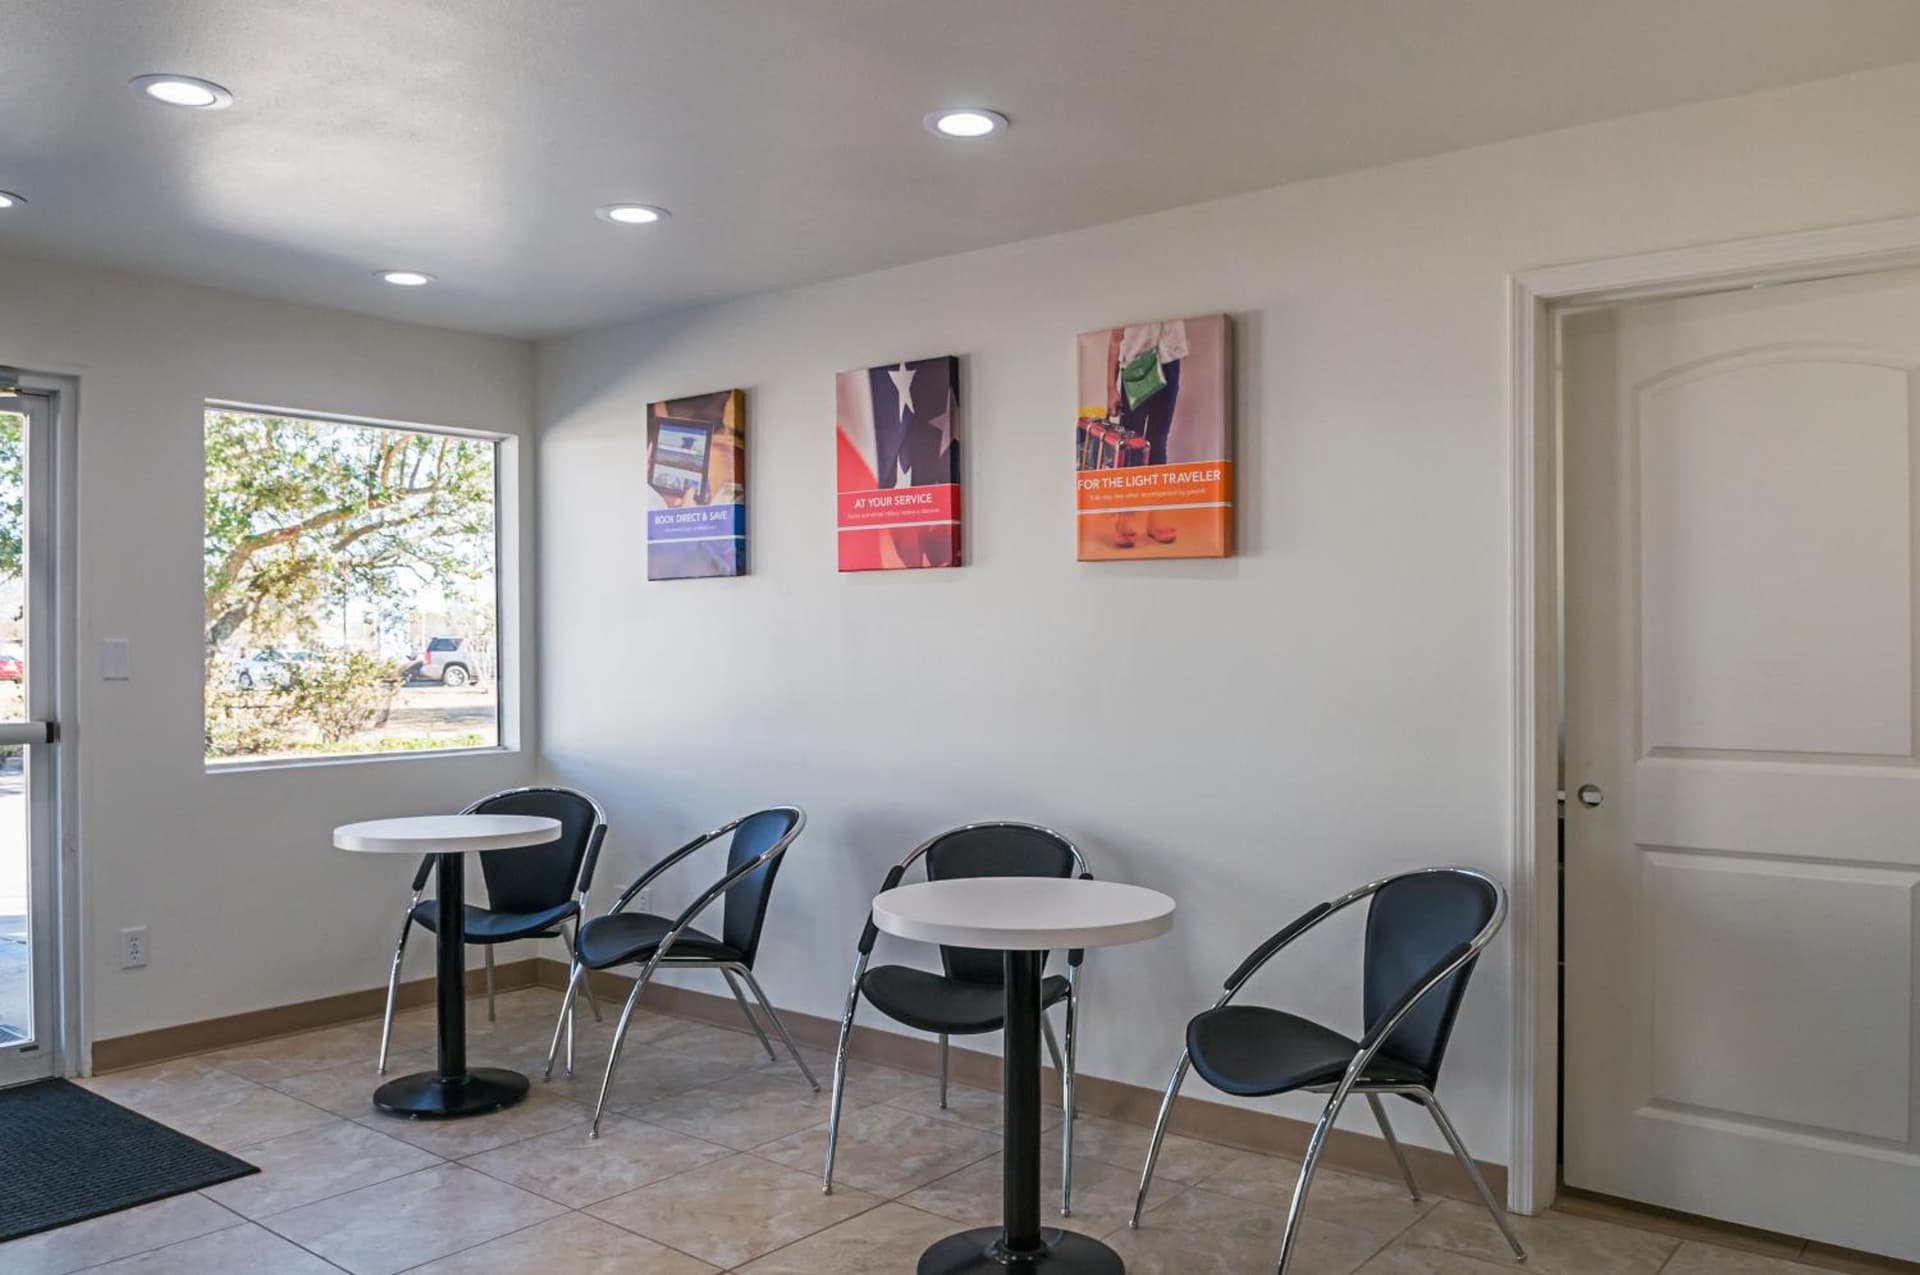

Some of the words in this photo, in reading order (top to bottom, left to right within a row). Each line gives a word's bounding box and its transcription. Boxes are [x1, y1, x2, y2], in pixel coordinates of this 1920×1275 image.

[1077, 478, 1100, 490] FOR
[1102, 476, 1124, 489] THE
[1125, 474, 1160, 488] LIGHT
[1162, 469, 1221, 485] TRAVELER
[854, 498, 866, 508] AT
[868, 495, 892, 507] YOUR
[894, 493, 932, 506] SERVICE
[655, 514, 674, 525] BOOK
[676, 512, 701, 523] DIRECT
[710, 510, 728, 521] SAVE
